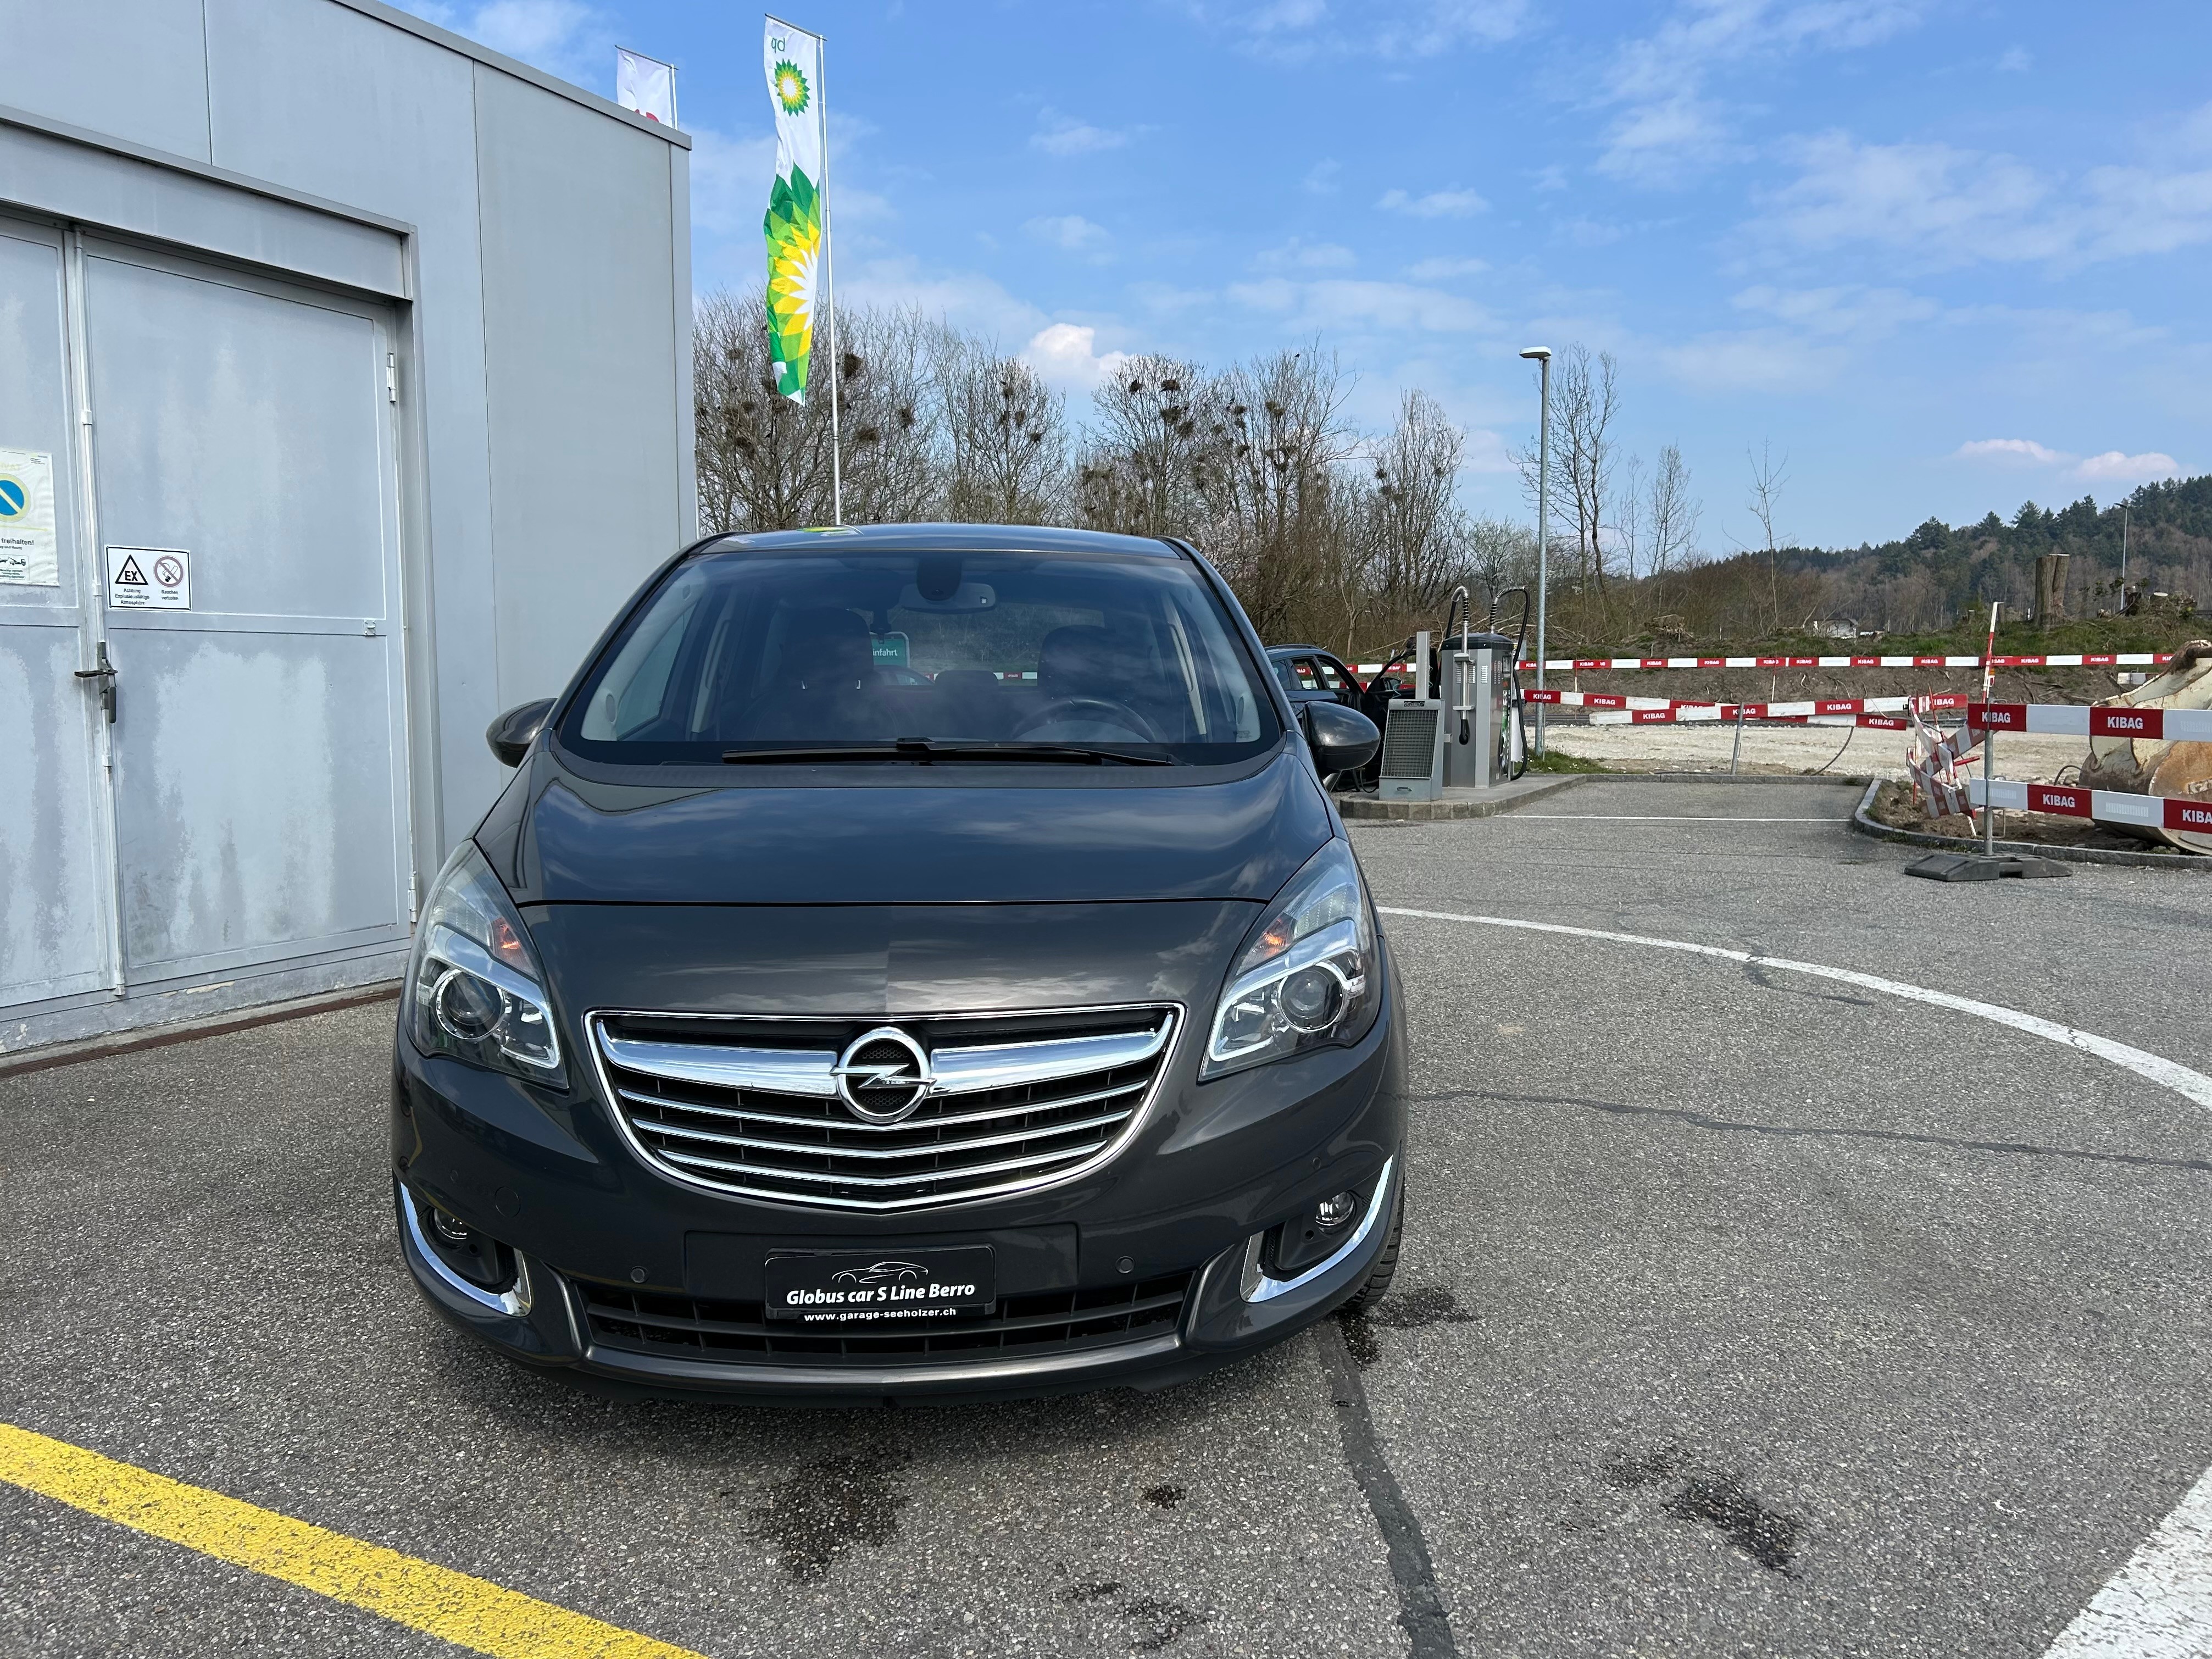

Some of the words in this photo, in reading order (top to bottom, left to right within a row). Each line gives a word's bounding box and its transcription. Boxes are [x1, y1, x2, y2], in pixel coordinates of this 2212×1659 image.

[125, 570, 138, 581] EX
[1869, 718, 1894, 726] KIBAG
[2107, 717, 2143, 729] KIBAG
[2043, 794, 2075, 808] KIBAG
[2182, 809, 2212, 824] KIBA
[787, 1289, 844, 1305] Globus
[848, 1291, 875, 1302] car
[876, 1286, 887, 1301] S
[890, 1285, 926, 1301] Line
[929, 1284, 975, 1298] Berro
[804, 1307, 957, 1322] www.garage-seeholzer.ch
